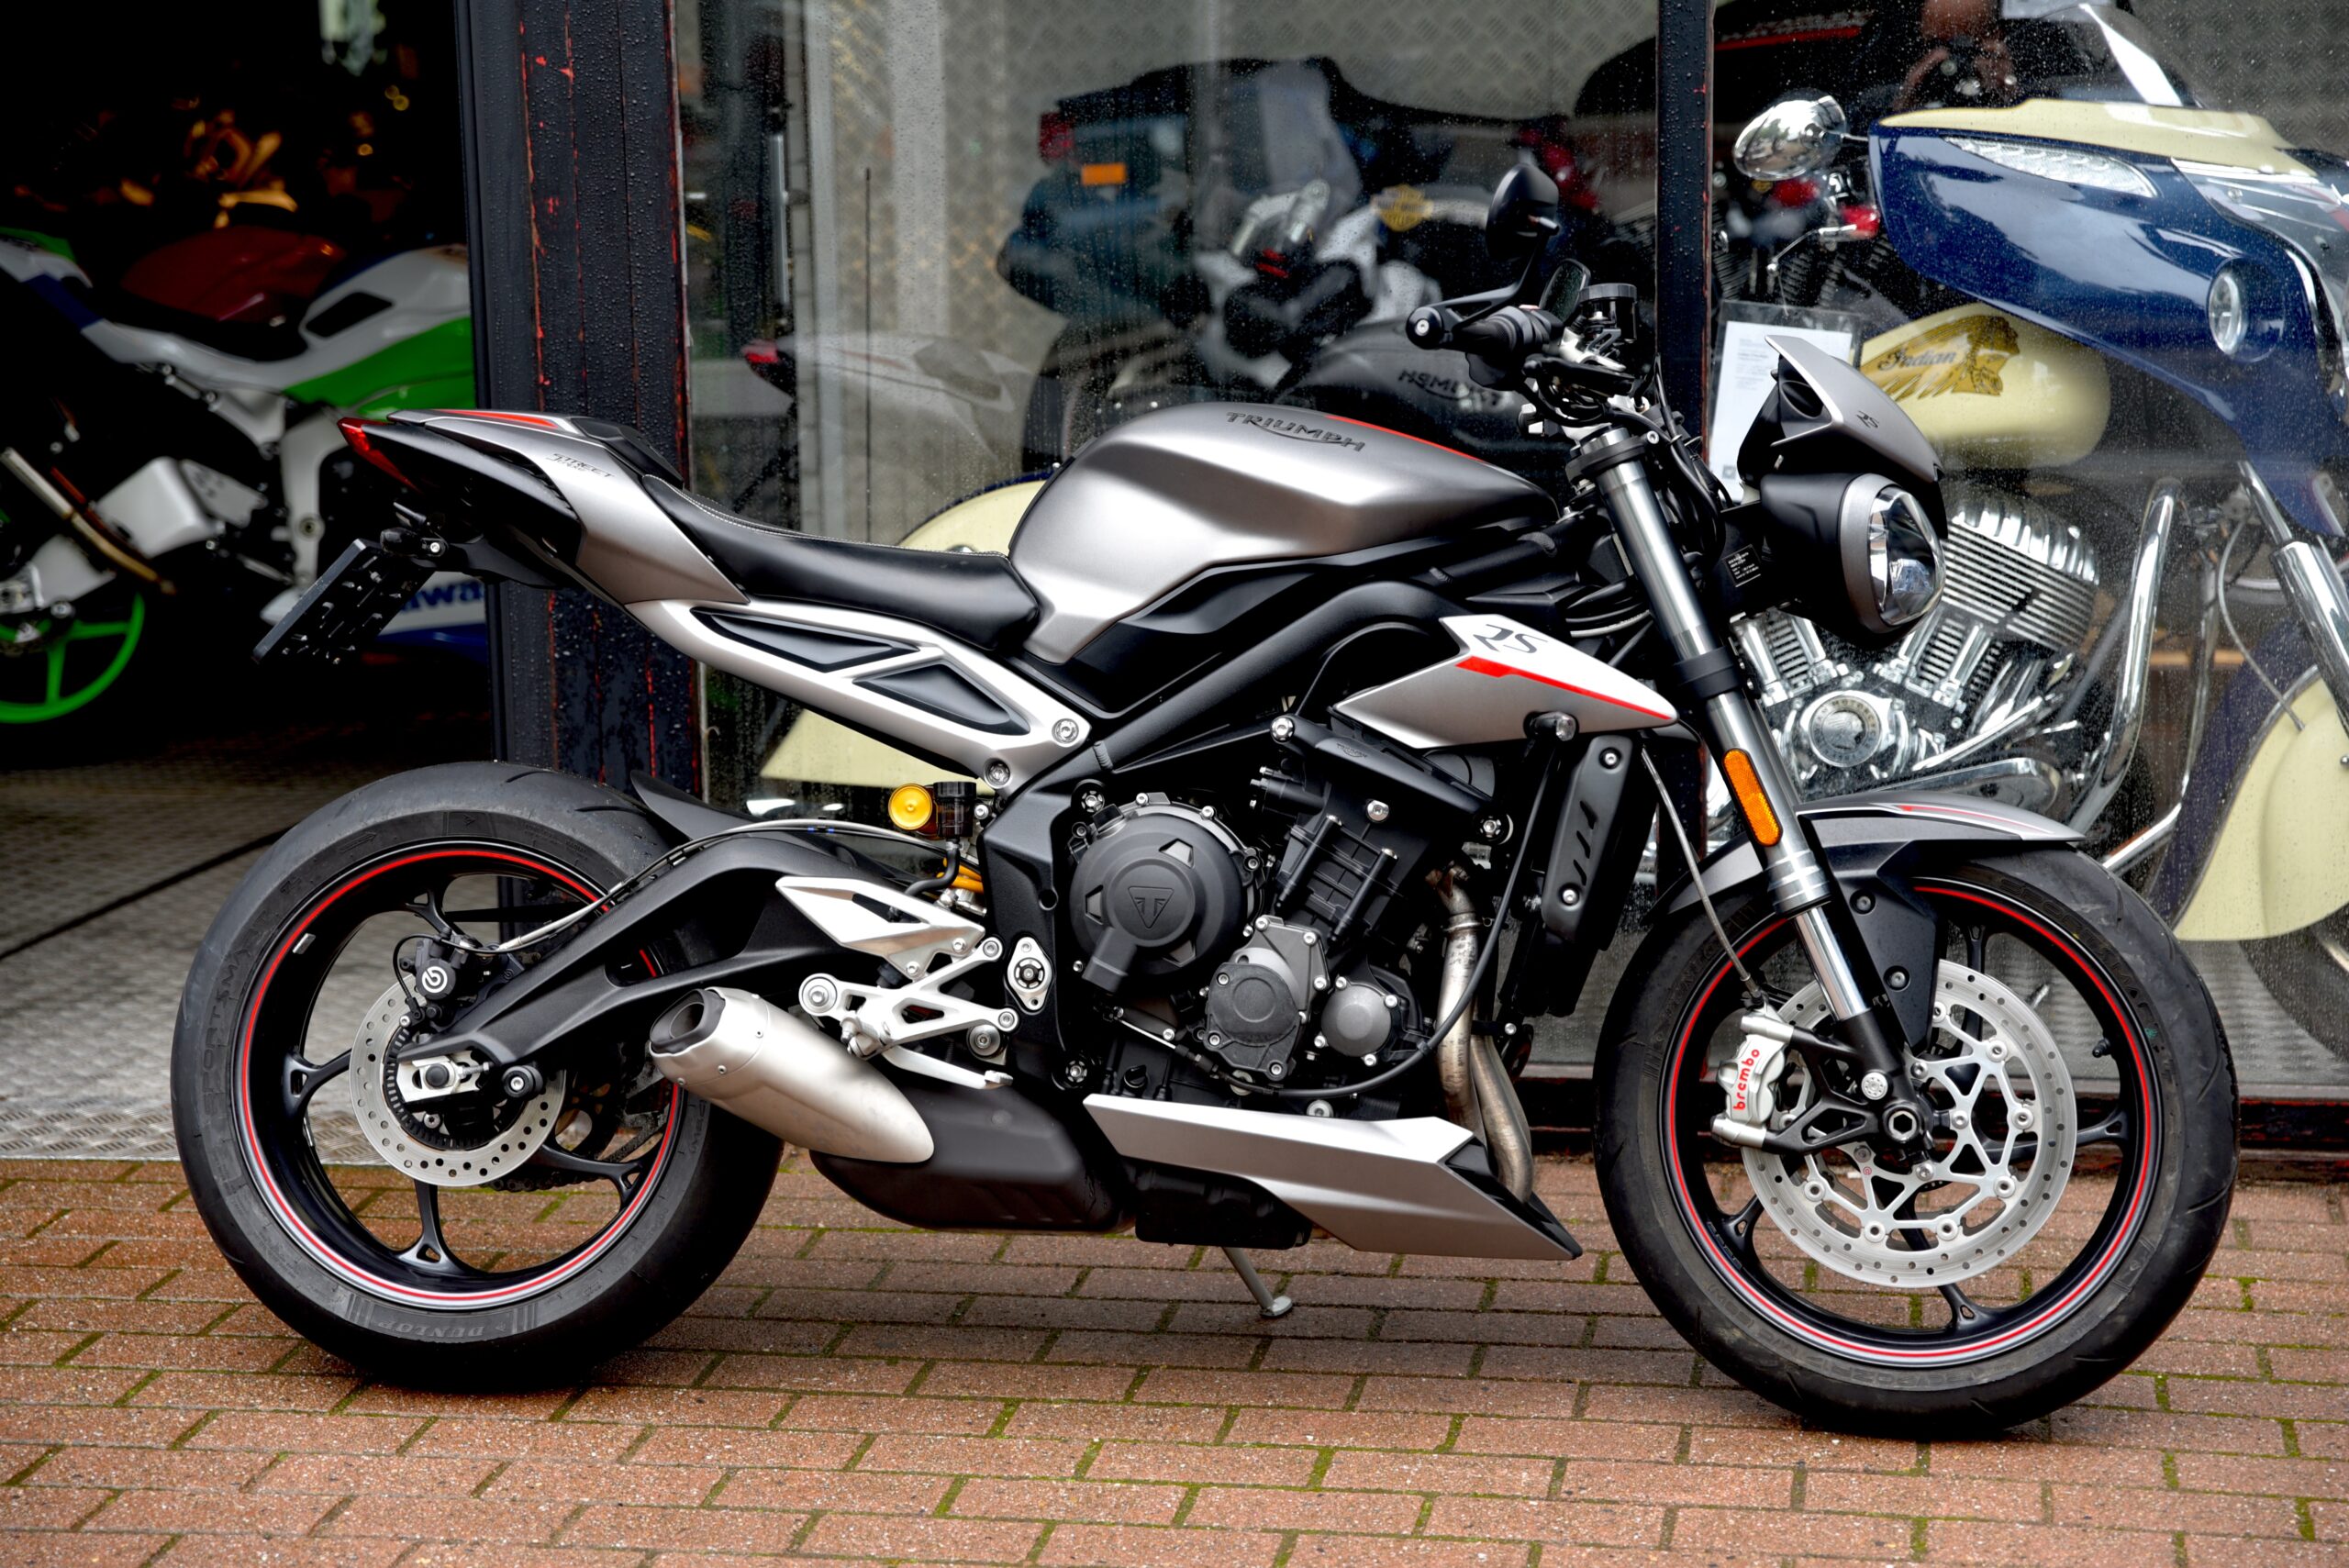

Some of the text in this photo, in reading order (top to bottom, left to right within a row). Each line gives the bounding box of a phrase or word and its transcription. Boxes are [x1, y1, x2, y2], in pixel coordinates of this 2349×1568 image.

[1877, 348, 1957, 372] Indian
[1226, 412, 1366, 452] TRIUMPH
[1472, 624, 1549, 653] RS
[1732, 1049, 1760, 1110] brembo
[377, 1320, 485, 1338] DUNLOP
